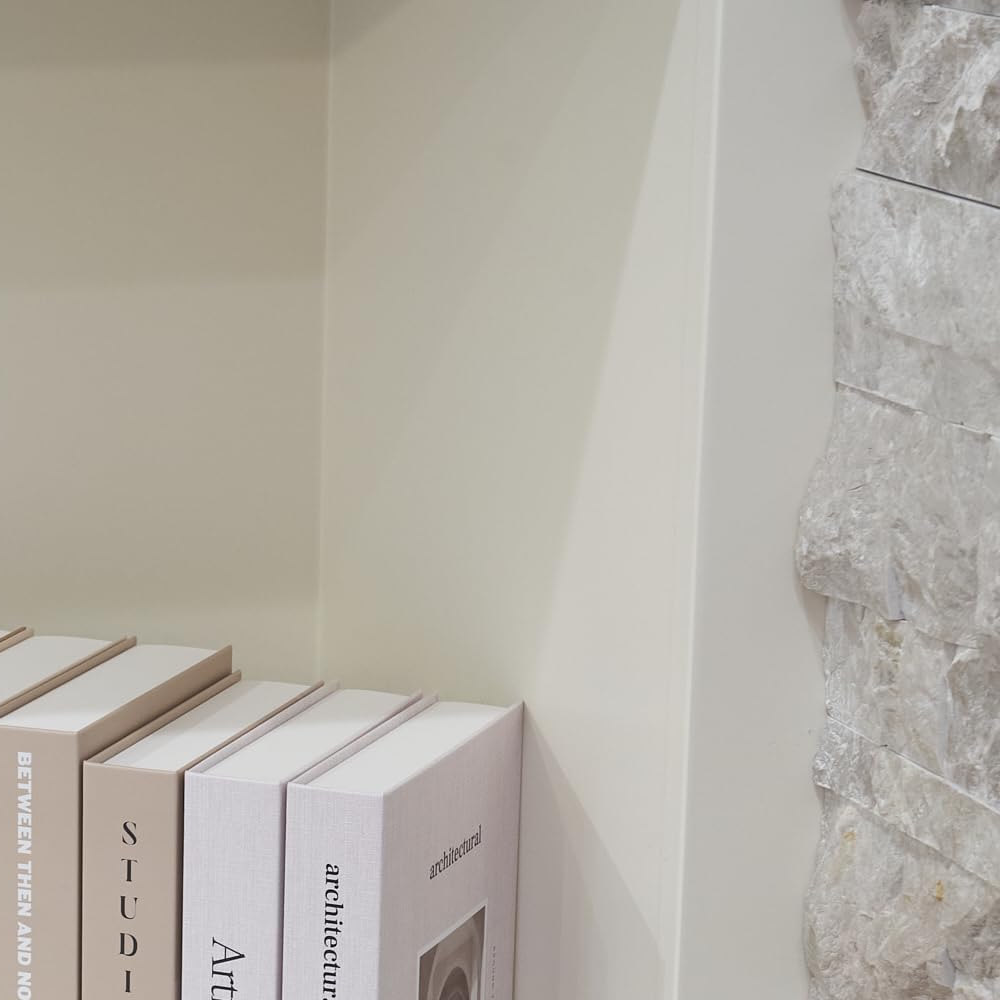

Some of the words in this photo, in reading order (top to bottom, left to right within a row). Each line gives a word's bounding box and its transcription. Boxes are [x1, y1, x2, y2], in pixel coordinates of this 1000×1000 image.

[17, 751, 33, 855] BETWEEN
[429, 823, 482, 880] architectural
[17, 860, 33, 917] THEN
[17, 921, 33, 966] AND
